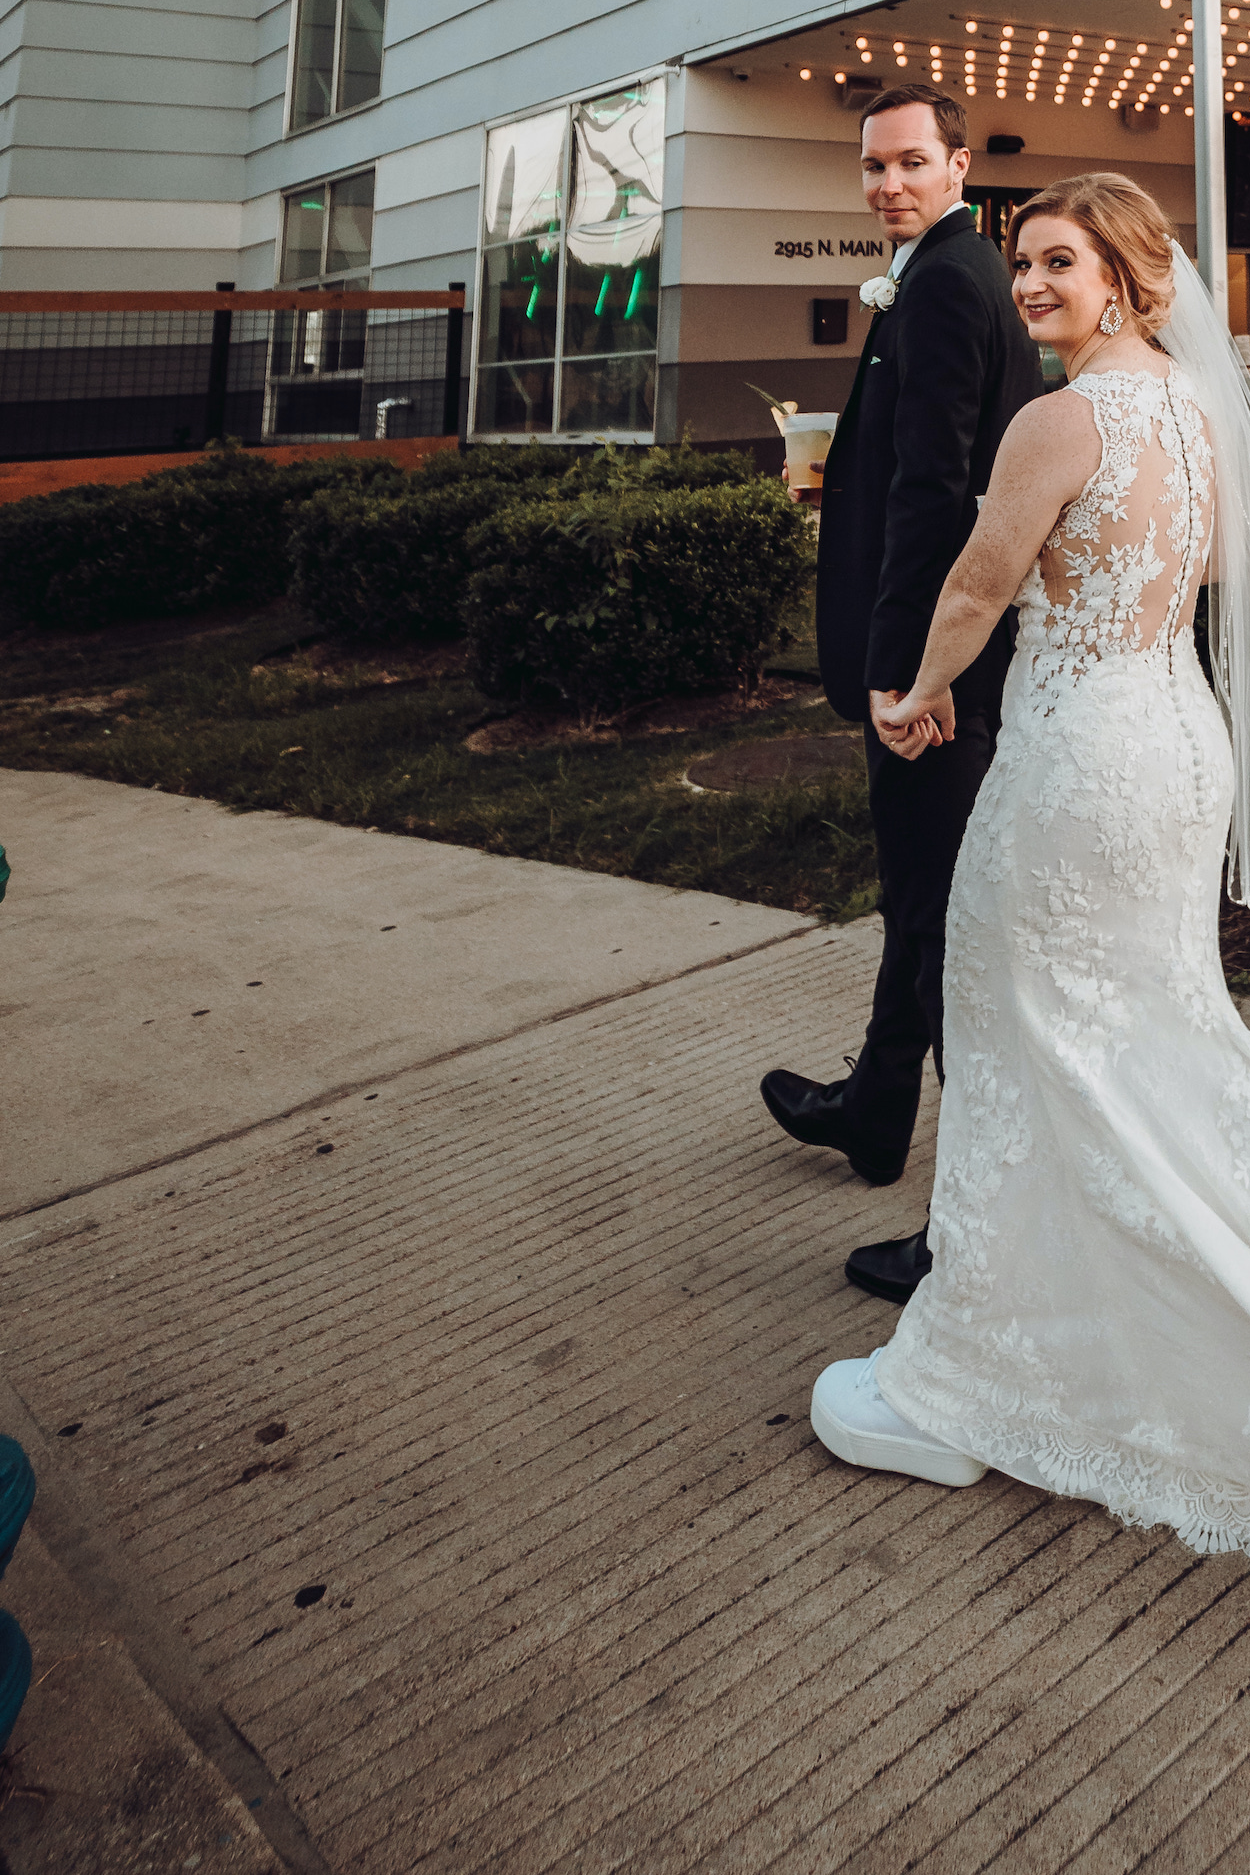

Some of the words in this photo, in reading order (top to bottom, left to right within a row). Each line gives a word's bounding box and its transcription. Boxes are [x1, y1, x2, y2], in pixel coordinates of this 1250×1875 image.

[774, 241, 814, 258] 2915
[818, 239, 834, 256] N.
[839, 240, 883, 257] MAIN
